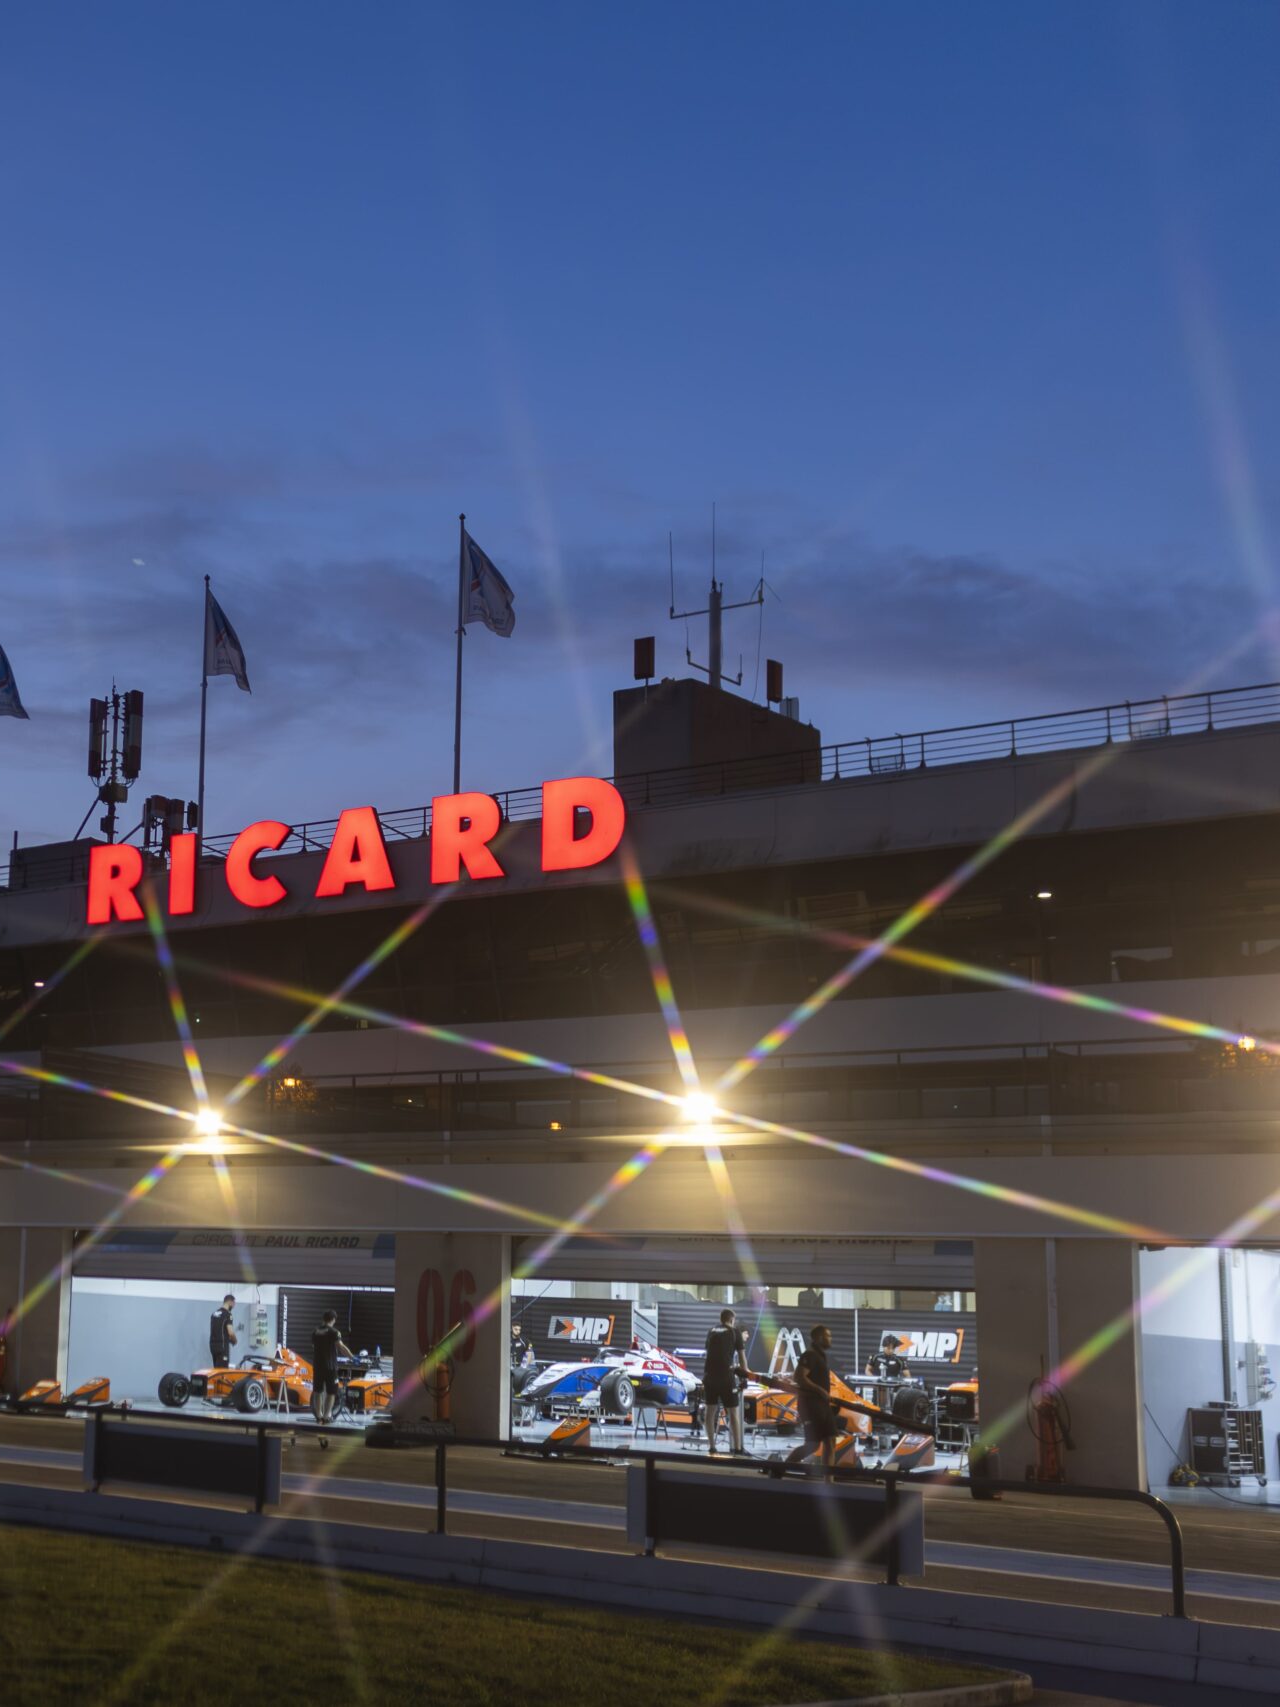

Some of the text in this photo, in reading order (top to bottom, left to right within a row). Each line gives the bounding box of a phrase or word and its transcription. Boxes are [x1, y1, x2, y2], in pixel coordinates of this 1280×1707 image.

[87, 777, 626, 925] RICARD
[265, 1235, 301, 1248] PAUL
[305, 1236, 360, 1249] RICARD
[416, 1268, 477, 1363] 06
